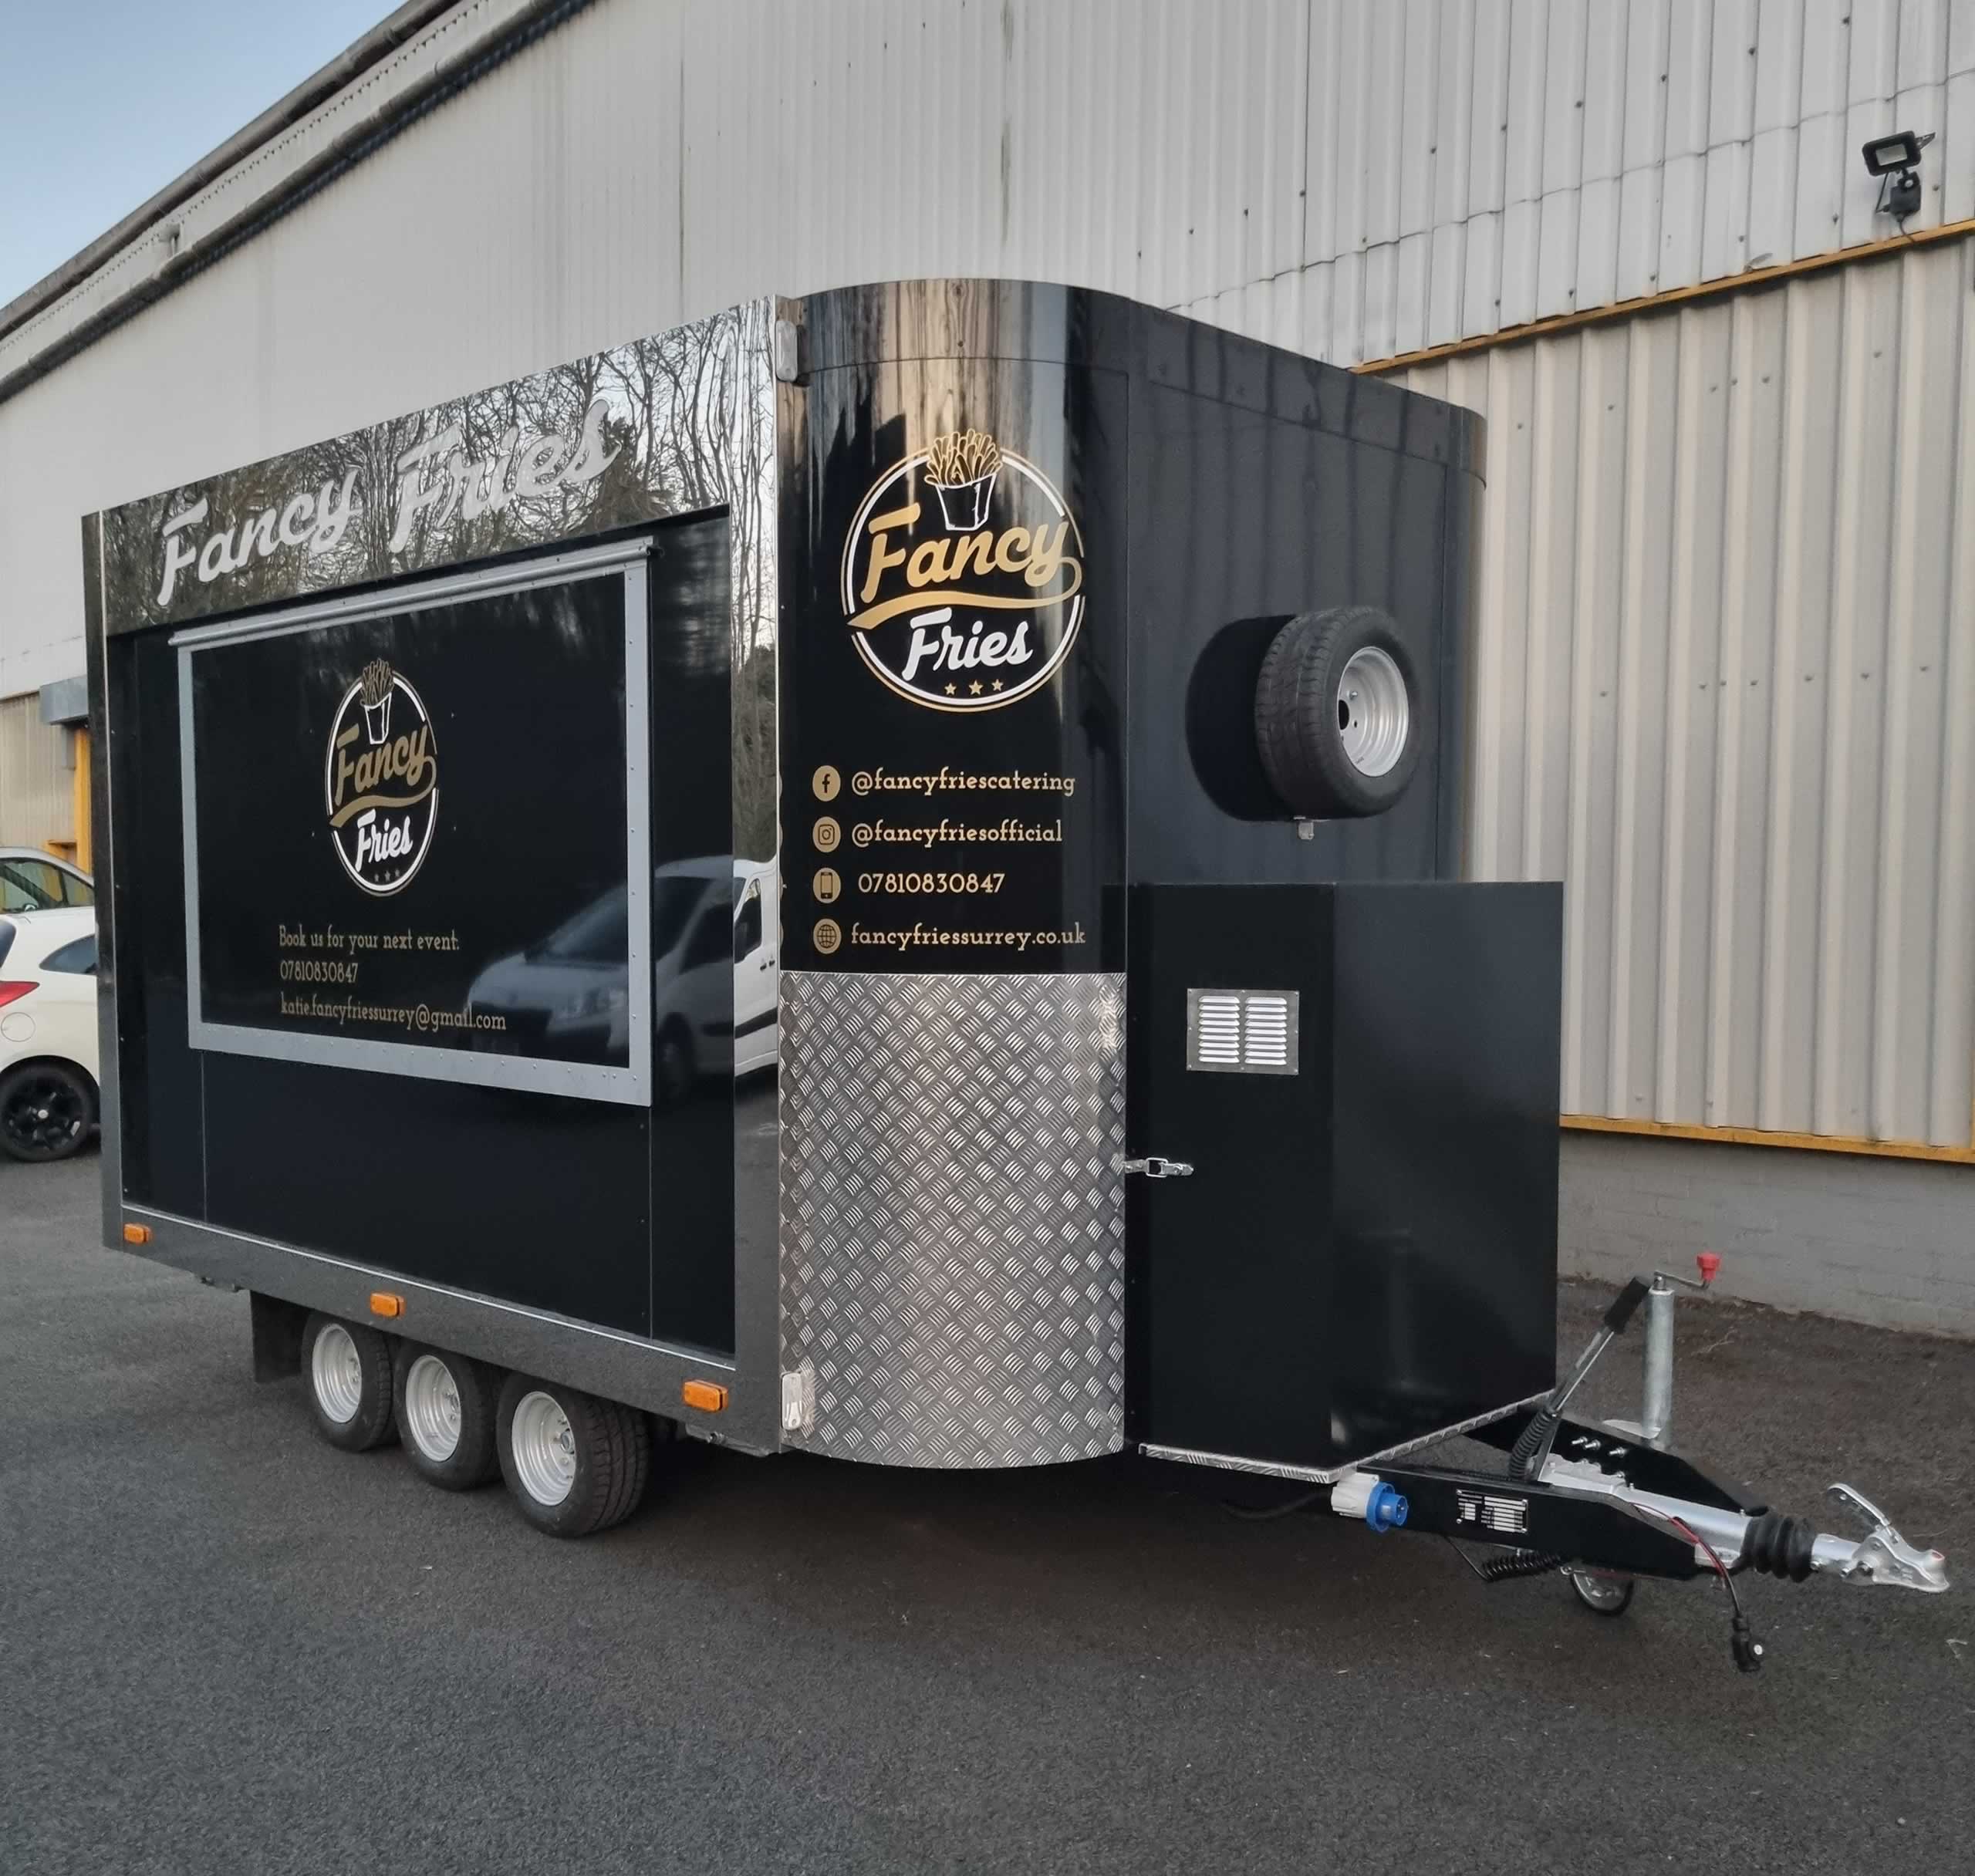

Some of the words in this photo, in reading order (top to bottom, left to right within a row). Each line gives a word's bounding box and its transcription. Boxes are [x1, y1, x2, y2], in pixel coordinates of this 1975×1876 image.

[157, 465, 363, 606] Fancy
[388, 393, 621, 553] Fries
[859, 501, 1082, 611] Fancy
[901, 607, 1033, 681] Fries
[333, 723, 437, 814] Fancy
[851, 767, 1076, 796] @fancyfriescatering
[354, 808, 414, 872] Fries
[851, 819, 1062, 848] @fancyfriesofficial
[858, 872, 1005, 893] 07810830847
[279, 923, 306, 947] Book
[311, 933, 323, 947] us
[327, 924, 344, 948] for
[349, 935, 379, 956] your
[383, 927, 413, 950] next
[417, 929, 460, 951] event.
[851, 922, 1086, 950] fancyfriessurrey.co.uk
[279, 960, 359, 984] 07810830847
[280, 991, 507, 1033] katie.fancyfriessurrey@gmail.com
